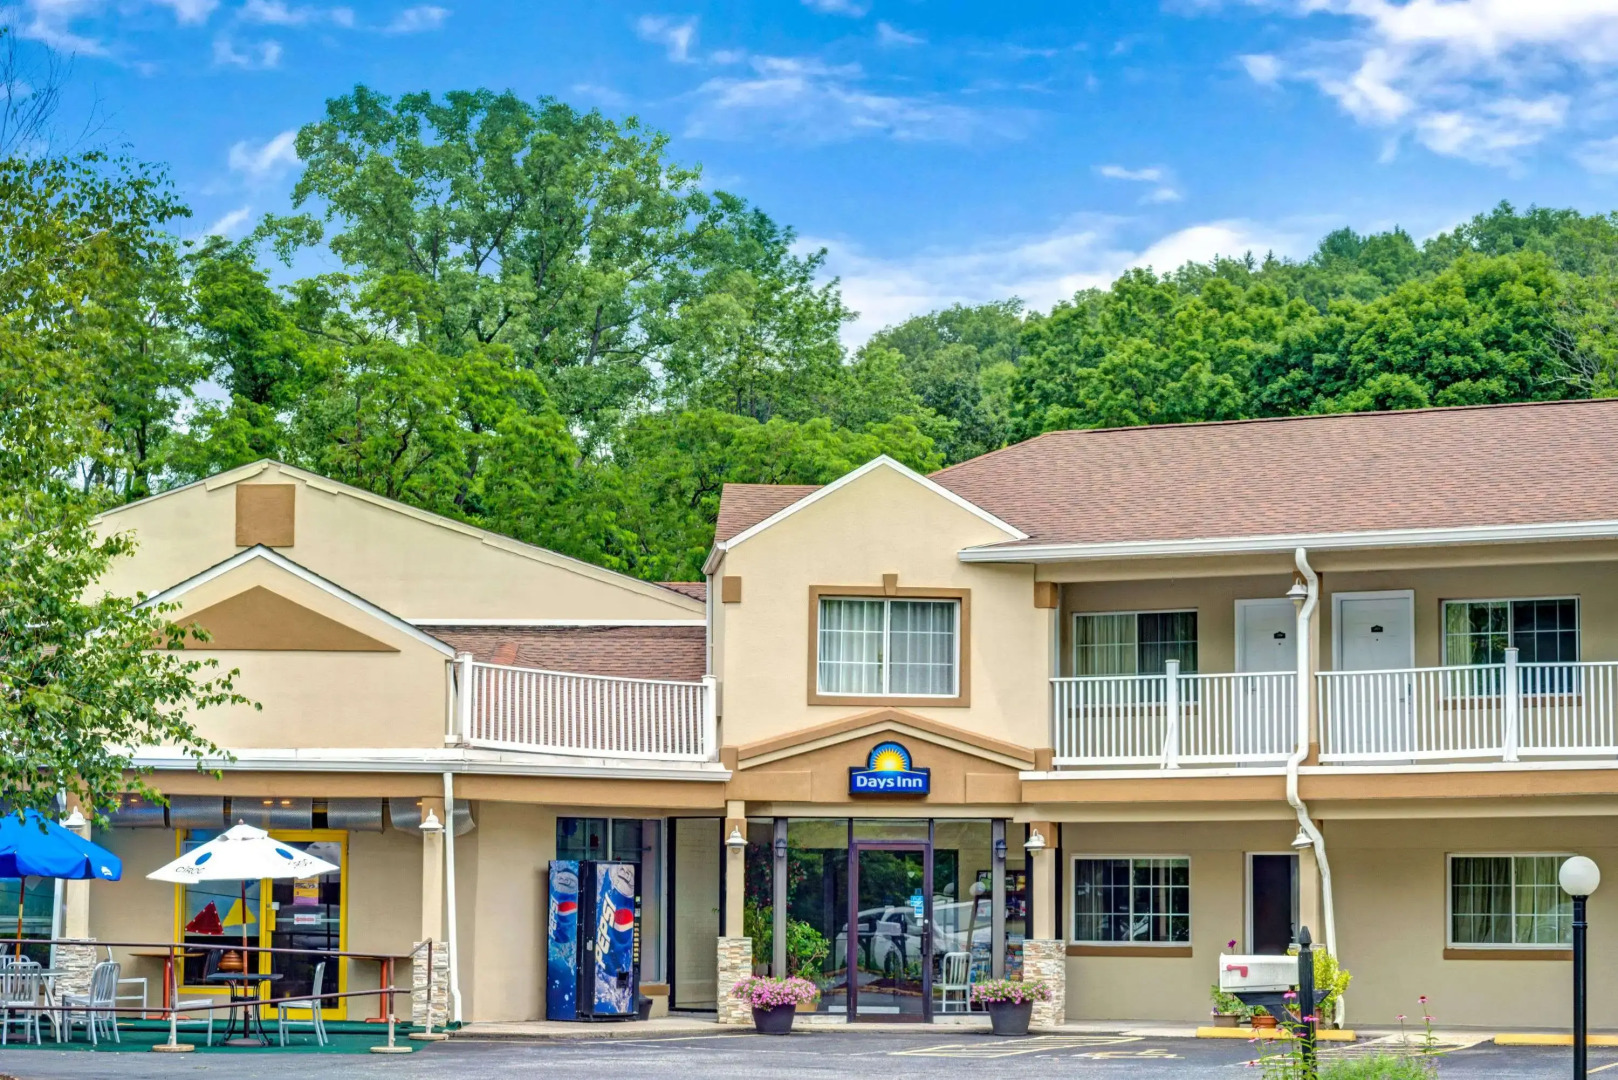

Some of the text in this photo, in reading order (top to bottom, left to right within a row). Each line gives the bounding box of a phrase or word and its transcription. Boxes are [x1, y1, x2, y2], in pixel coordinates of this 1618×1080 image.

[856, 775, 923, 789] Days Inn
[549, 894, 559, 940] PEPSI
[595, 892, 616, 970] PEPSI
